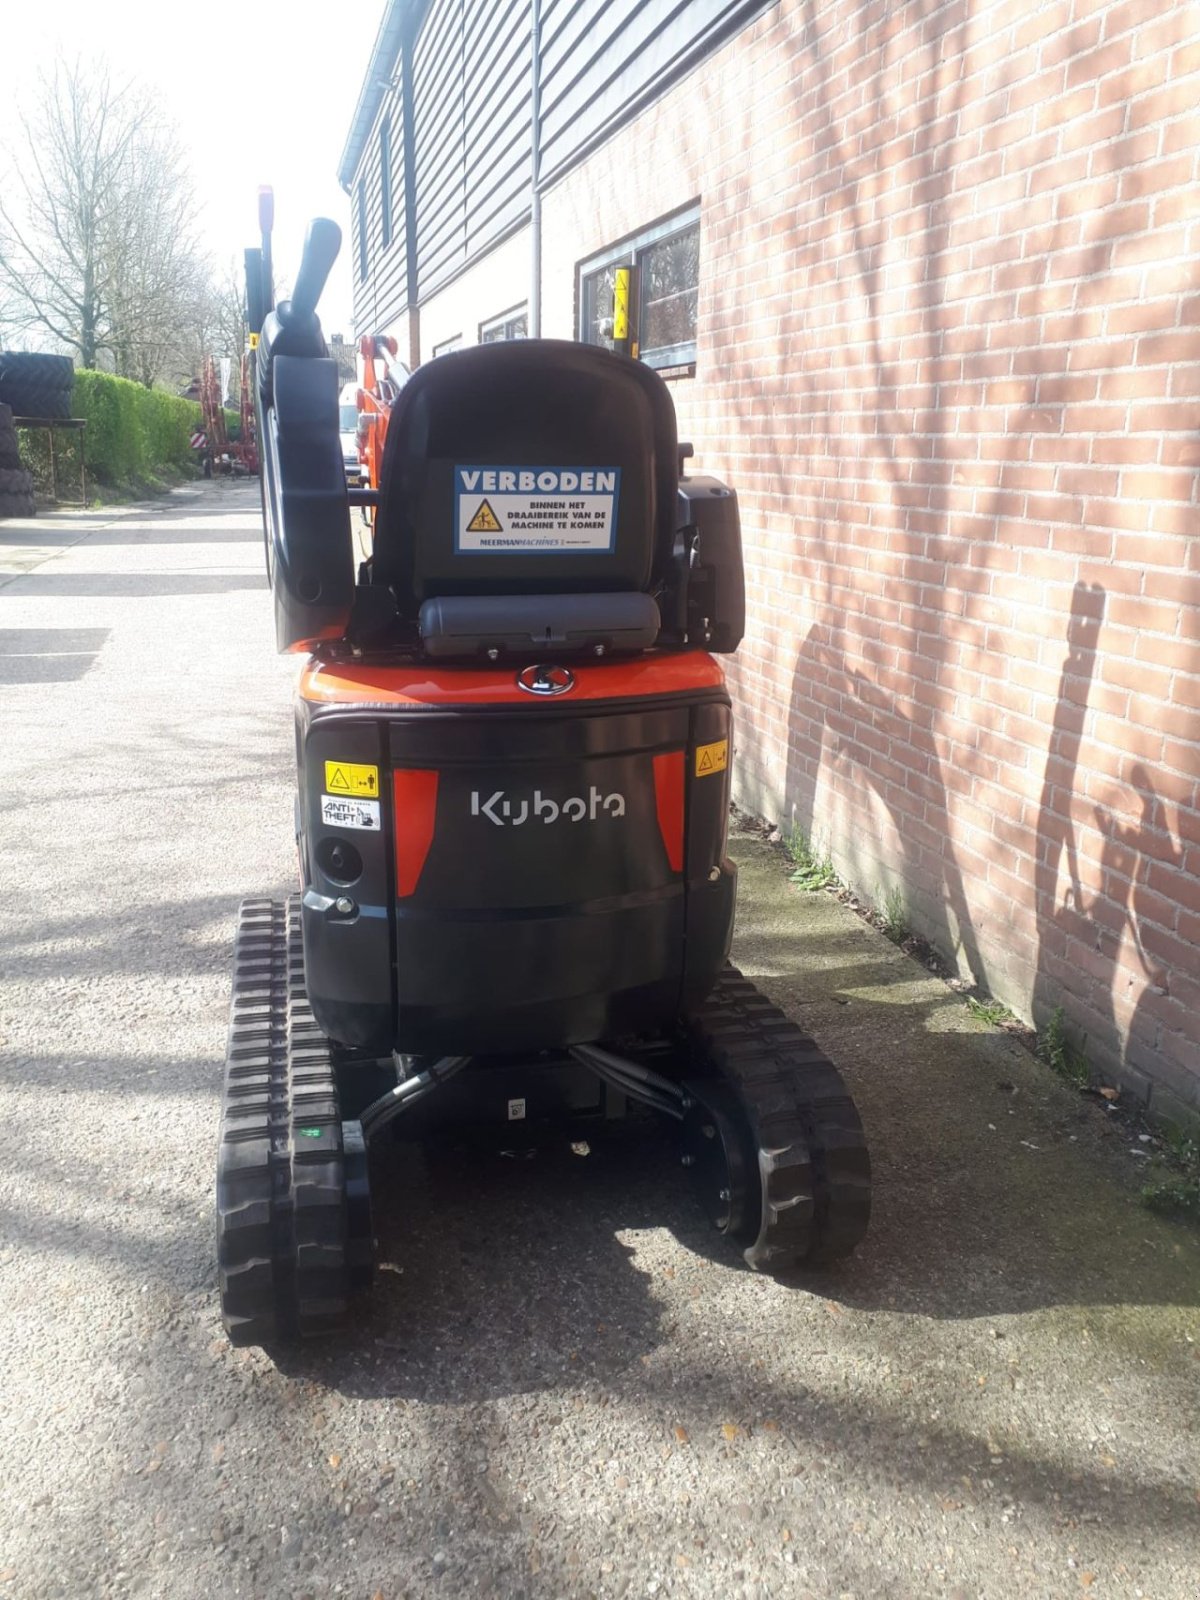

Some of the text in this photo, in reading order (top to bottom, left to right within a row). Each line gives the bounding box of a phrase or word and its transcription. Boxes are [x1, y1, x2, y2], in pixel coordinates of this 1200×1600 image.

[460, 471, 615, 491] VERBODEN
[507, 511, 569, 519] DRAAIBEREIK
[572, 511, 591, 519] VAN
[511, 521, 604, 529] MACHINE TE KOMEN
[471, 786, 625, 826] Kubota
[323, 810, 356, 822] THEFT
